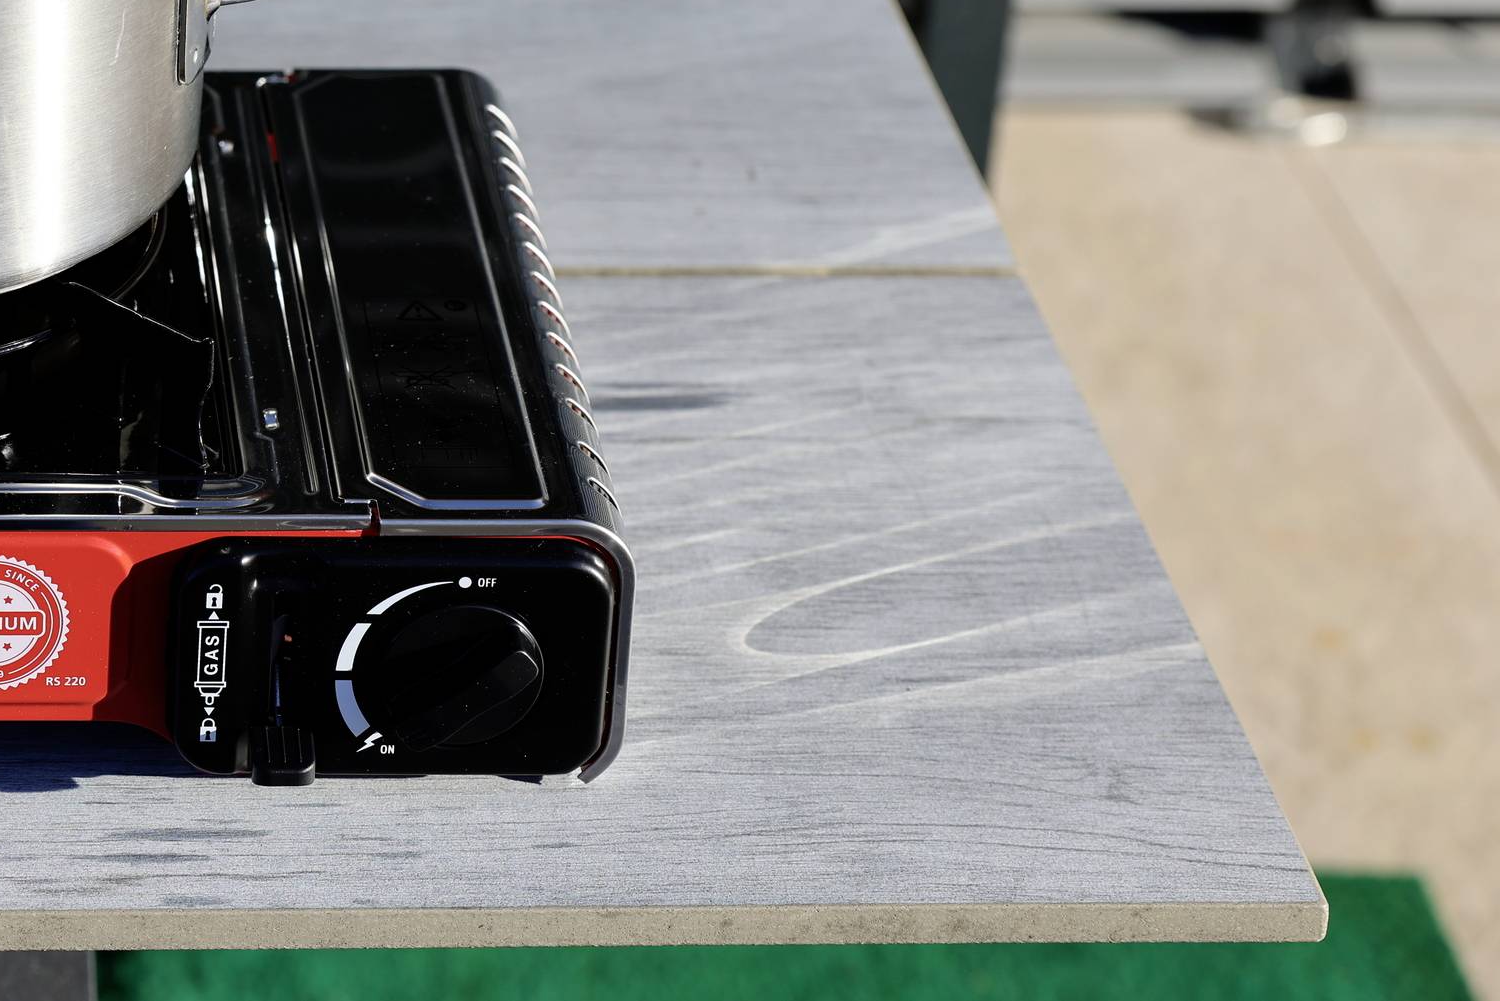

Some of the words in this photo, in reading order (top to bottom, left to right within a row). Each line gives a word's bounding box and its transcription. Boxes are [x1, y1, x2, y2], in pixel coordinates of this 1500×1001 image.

[4, 569, 40, 592] SINCE
[477, 577, 497, 588] OFF
[203, 634, 220, 676] GAS
[45, 676, 61, 687] RS
[63, 676, 86, 686] 220
[379, 744, 395, 755] ON
